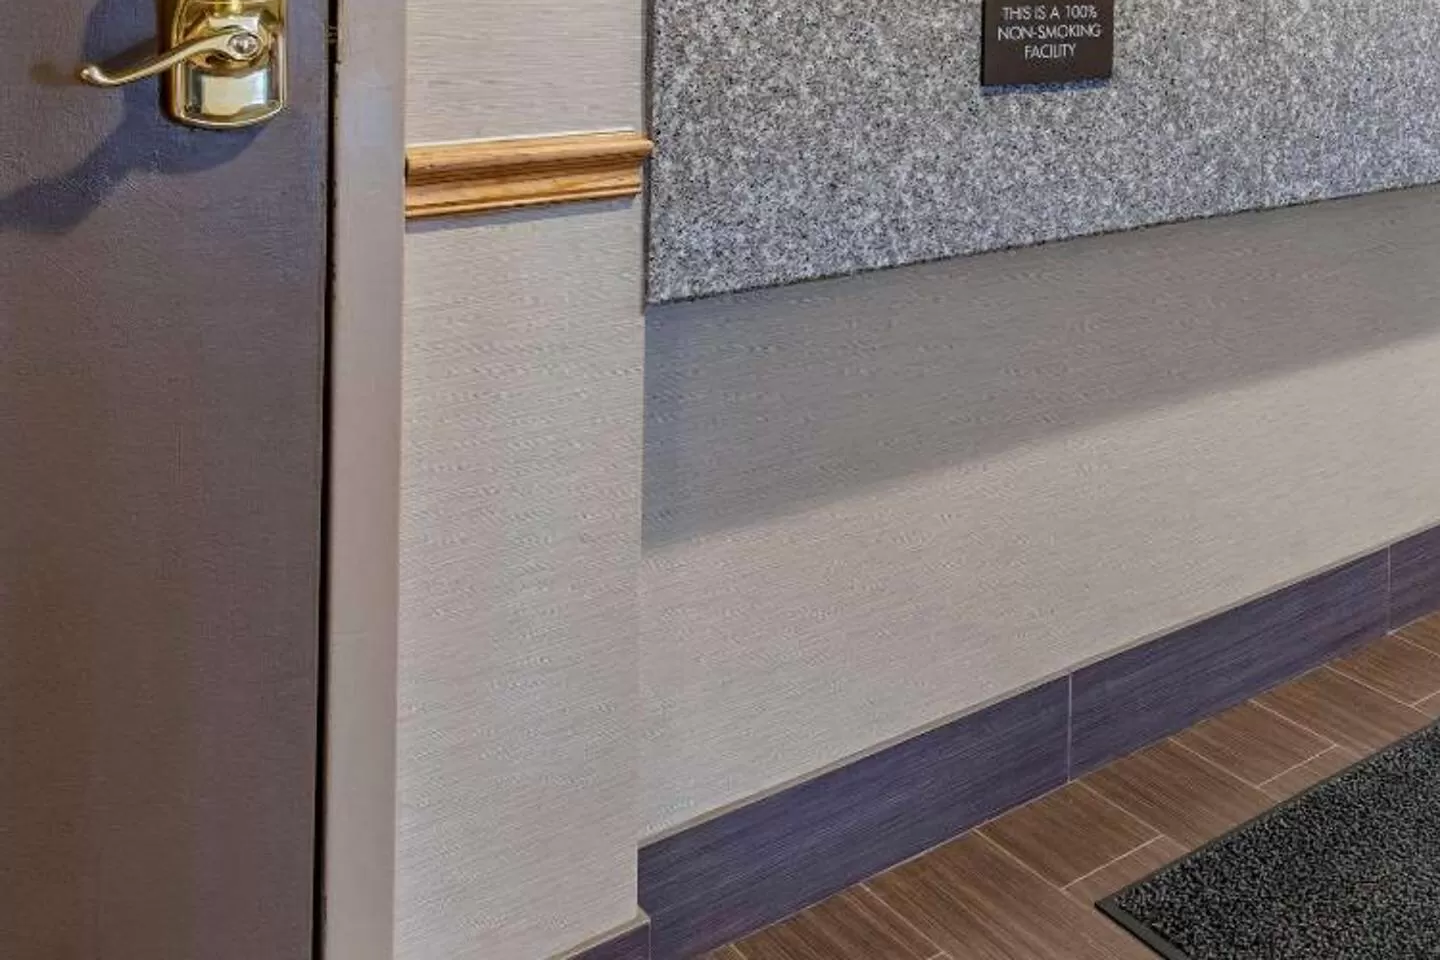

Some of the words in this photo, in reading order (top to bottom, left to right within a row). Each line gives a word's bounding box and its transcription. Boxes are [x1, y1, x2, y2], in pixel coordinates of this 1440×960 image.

[1002, 6, 1032, 21] THIS
[1035, 6, 1047, 20] IS
[1050, 5, 1060, 20] A
[1065, 4, 1098, 19] 100%
[997, 23, 1102, 41] NON-SMOKING
[1024, 43, 1077, 60] FACILITY
